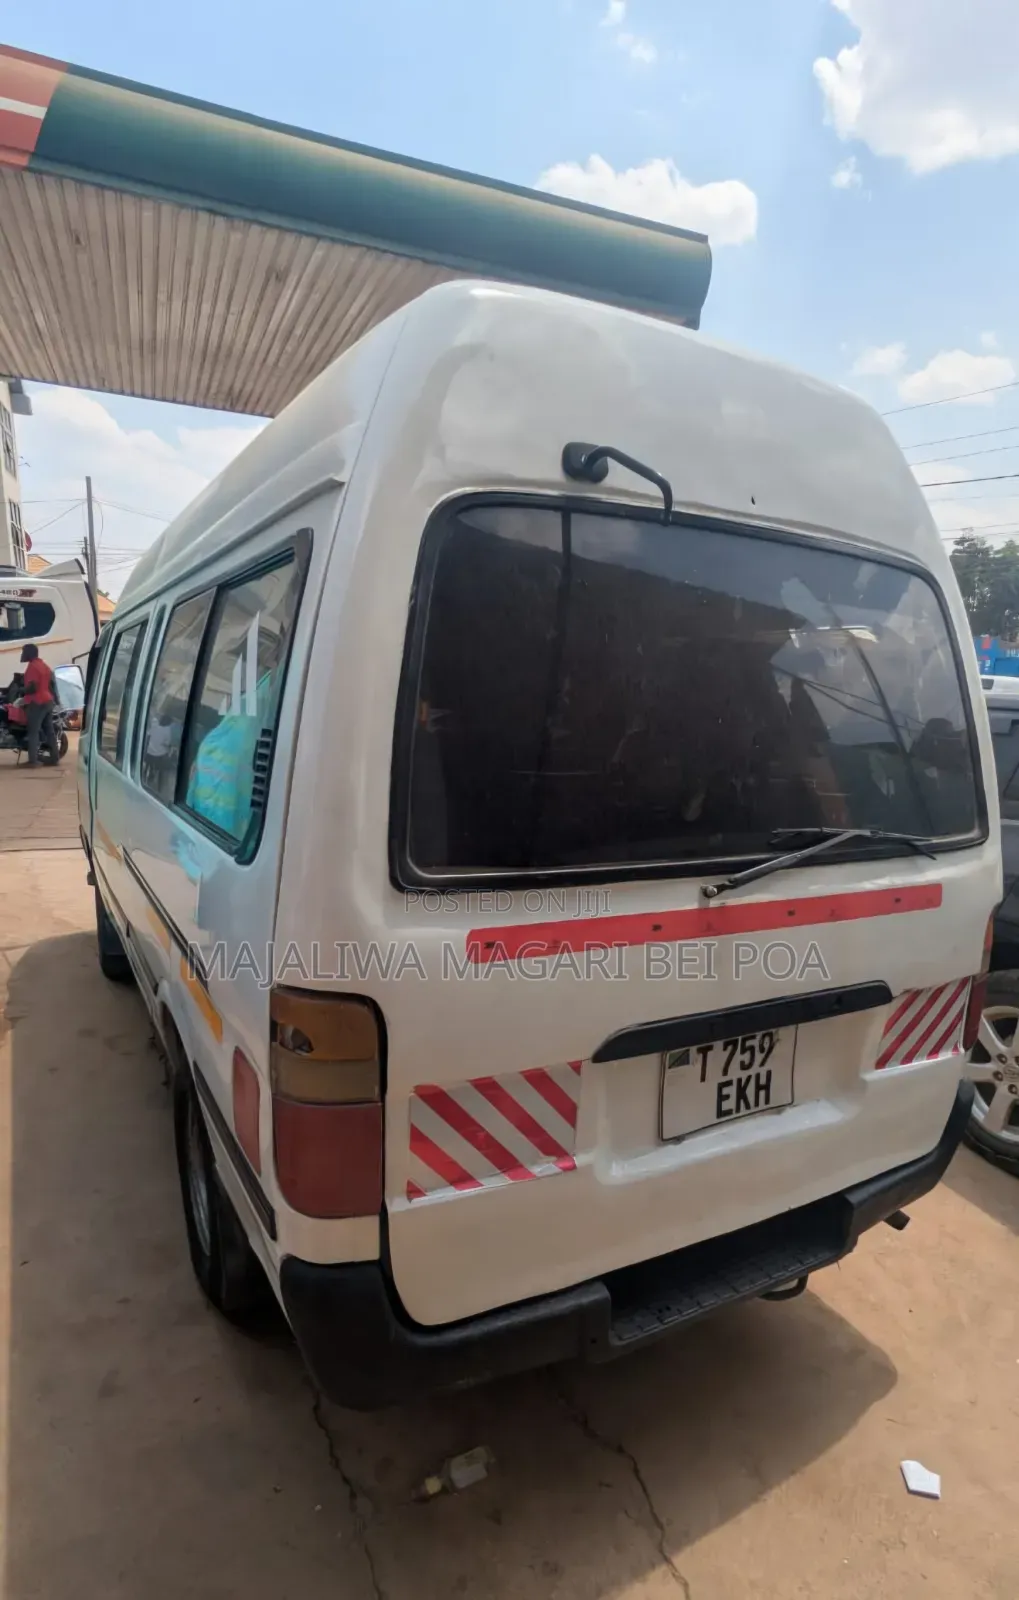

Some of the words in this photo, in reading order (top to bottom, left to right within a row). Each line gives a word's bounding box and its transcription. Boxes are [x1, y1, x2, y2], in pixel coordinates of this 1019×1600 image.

[696, 1045, 714, 1083] T
[722, 1031, 775, 1077] 759
[716, 1069, 772, 1119] EKH
